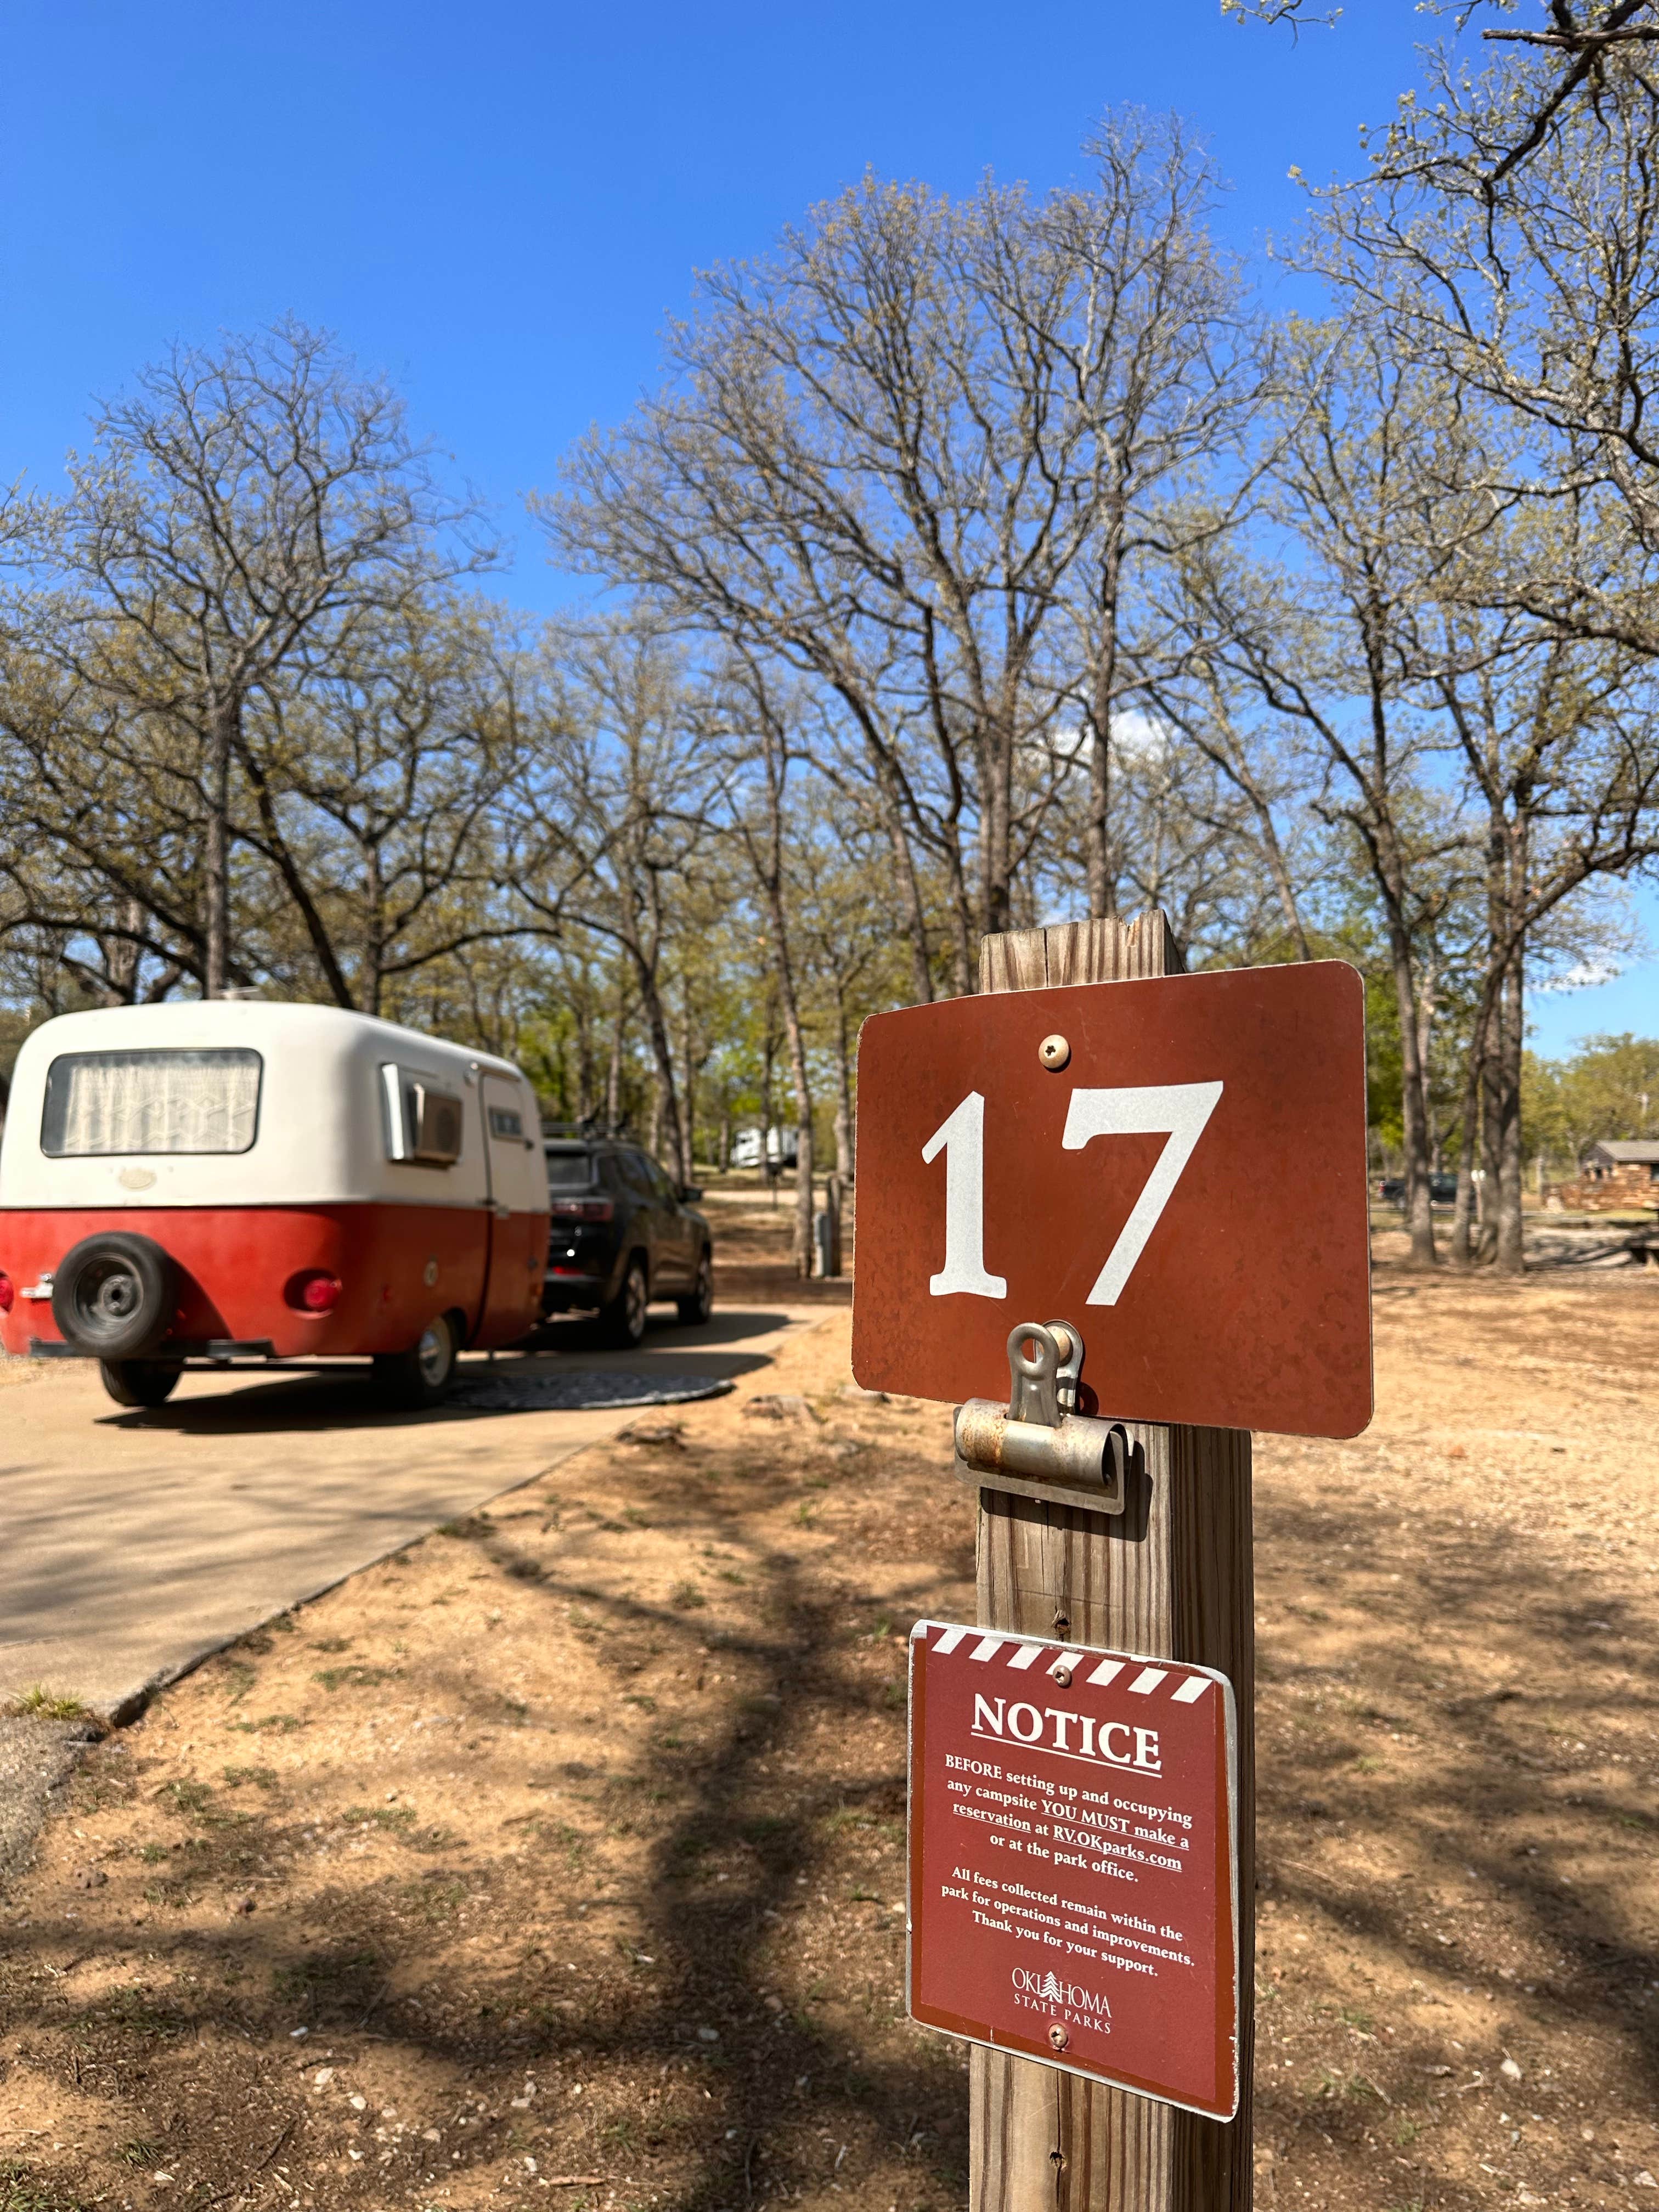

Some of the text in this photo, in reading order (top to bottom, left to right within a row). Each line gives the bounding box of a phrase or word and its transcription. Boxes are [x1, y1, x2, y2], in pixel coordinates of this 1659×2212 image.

[922, 1081, 1224, 1306] 17
[971, 1693, 1162, 1771] NOTICE
[945, 1754, 1193, 1830] BEFORE setting up and occupying
[947, 1780, 1189, 1849] any campsite YOU MUST make a
[952, 1803, 1182, 1870] reservation at RV.OKparks.com
[990, 1835, 1138, 1883] or at the park office.
[941, 1884, 1195, 1966] park for operations and improvements.
[952, 1866, 1183, 1941] All fees collected remain within the
[972, 1910, 1158, 1976] Thank you for your support.
[1014, 1993, 1111, 2034] STATE PARKS
